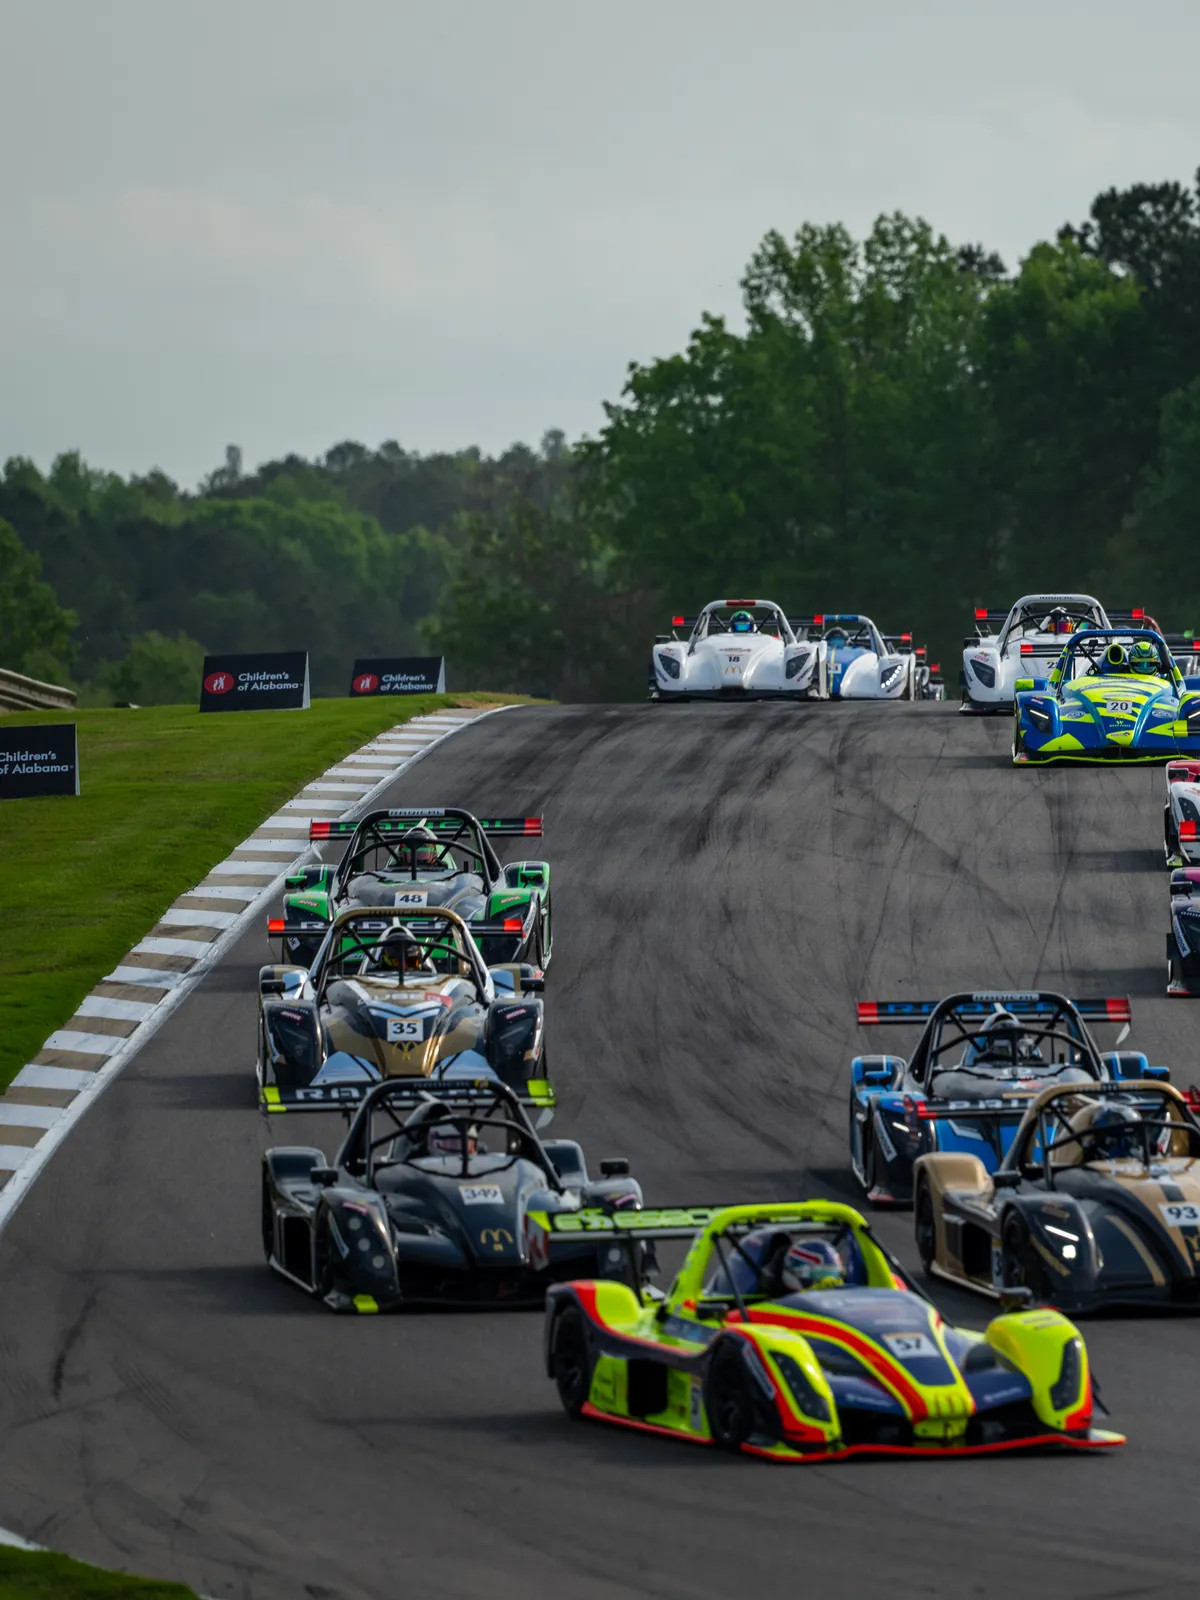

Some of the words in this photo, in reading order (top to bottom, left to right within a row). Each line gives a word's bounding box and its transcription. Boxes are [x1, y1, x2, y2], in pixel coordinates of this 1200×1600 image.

[238, 671, 290, 681] Children's
[381, 674, 426, 683] Children's
[237, 682, 250, 691] of
[251, 681, 299, 690] Alabama
[380, 683, 392, 691] of
[393, 682, 434, 690] Alabama
[1110, 701, 1129, 711] 20
[0, 750, 57, 763] Children's
[12, 763, 69, 774] Alabama
[398, 893, 423, 905] 48
[301, 921, 487, 931] RDCAL
[392, 1022, 418, 1035] 35
[1166, 1206, 1198, 1219] 93
[894, 1337, 922, 1351] 57
